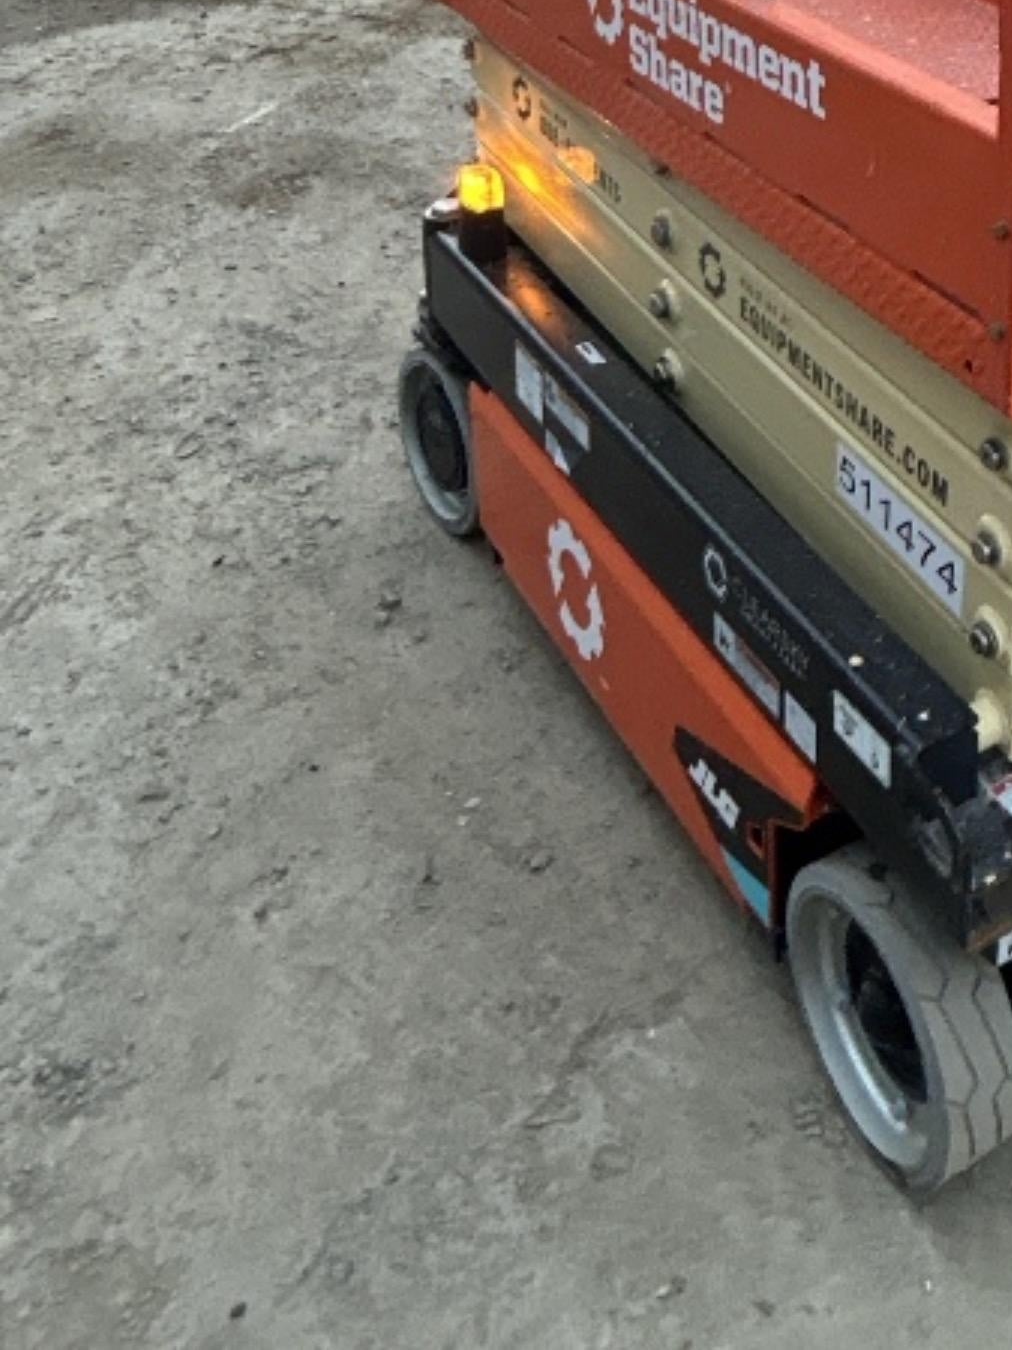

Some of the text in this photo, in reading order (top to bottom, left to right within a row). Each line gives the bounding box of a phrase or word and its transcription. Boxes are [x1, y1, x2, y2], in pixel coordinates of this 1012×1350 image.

[629, 23, 725, 125] Share
[739, 296, 950, 508] EQUIPMENTSHARE.COM
[839, 454, 958, 596] 511474
[688, 758, 741, 830] JLG
